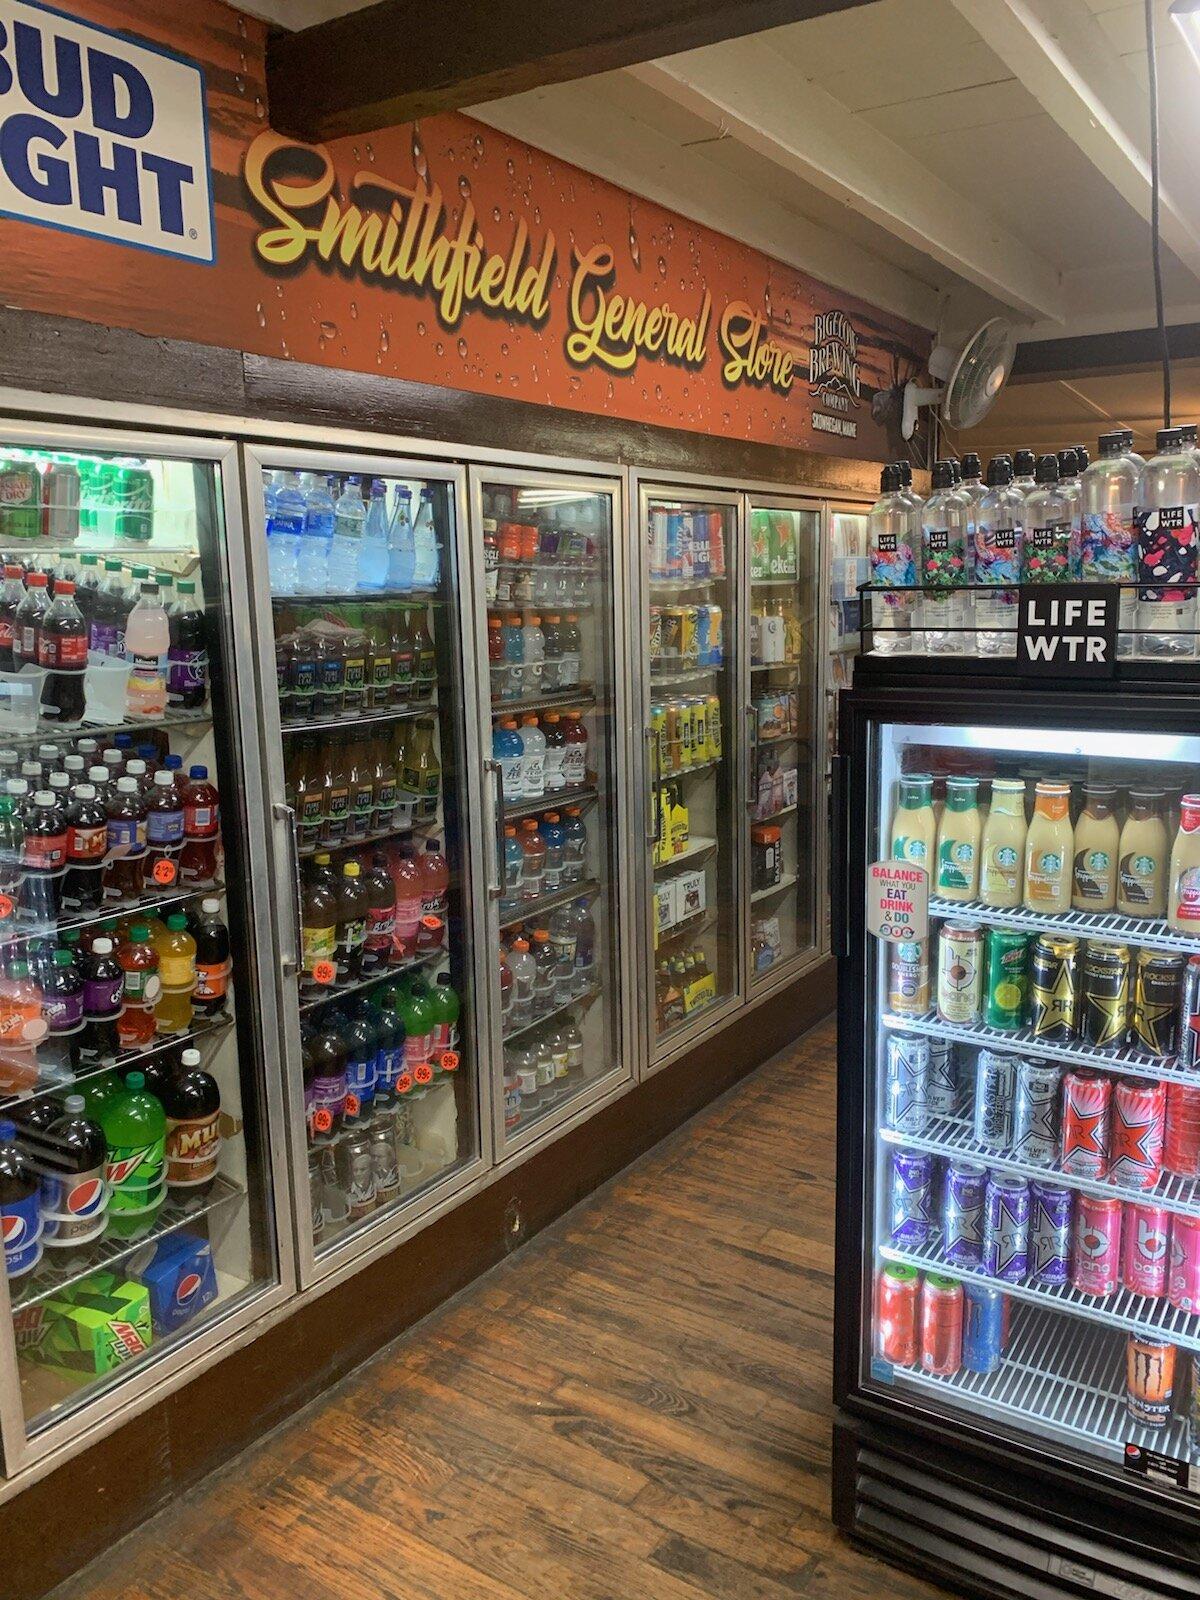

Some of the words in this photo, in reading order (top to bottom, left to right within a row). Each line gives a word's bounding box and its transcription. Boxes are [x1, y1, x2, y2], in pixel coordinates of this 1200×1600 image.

[245, 130, 556, 324] Smithfield
[567, 244, 711, 370] General
[720, 299, 794, 388] Store
[810, 341, 860, 398] BREWING
[1161, 510, 1182, 519] LIFE
[1161, 519, 1183, 527] WTR
[996, 531, 1013, 539] LIFE
[1028, 600, 1106, 627] LIFE
[1024, 636, 1107, 663] WTR
[872, 867, 923, 883] BALANCE
[683, 878, 701, 891] TRULY
[880, 879, 899, 887] WHAT
[902, 881, 916, 890] YOU
[887, 889, 907, 900] EAT
[880, 898, 914, 913] DRINK
[884, 911, 892, 922] &
[894, 912, 909, 923] DO
